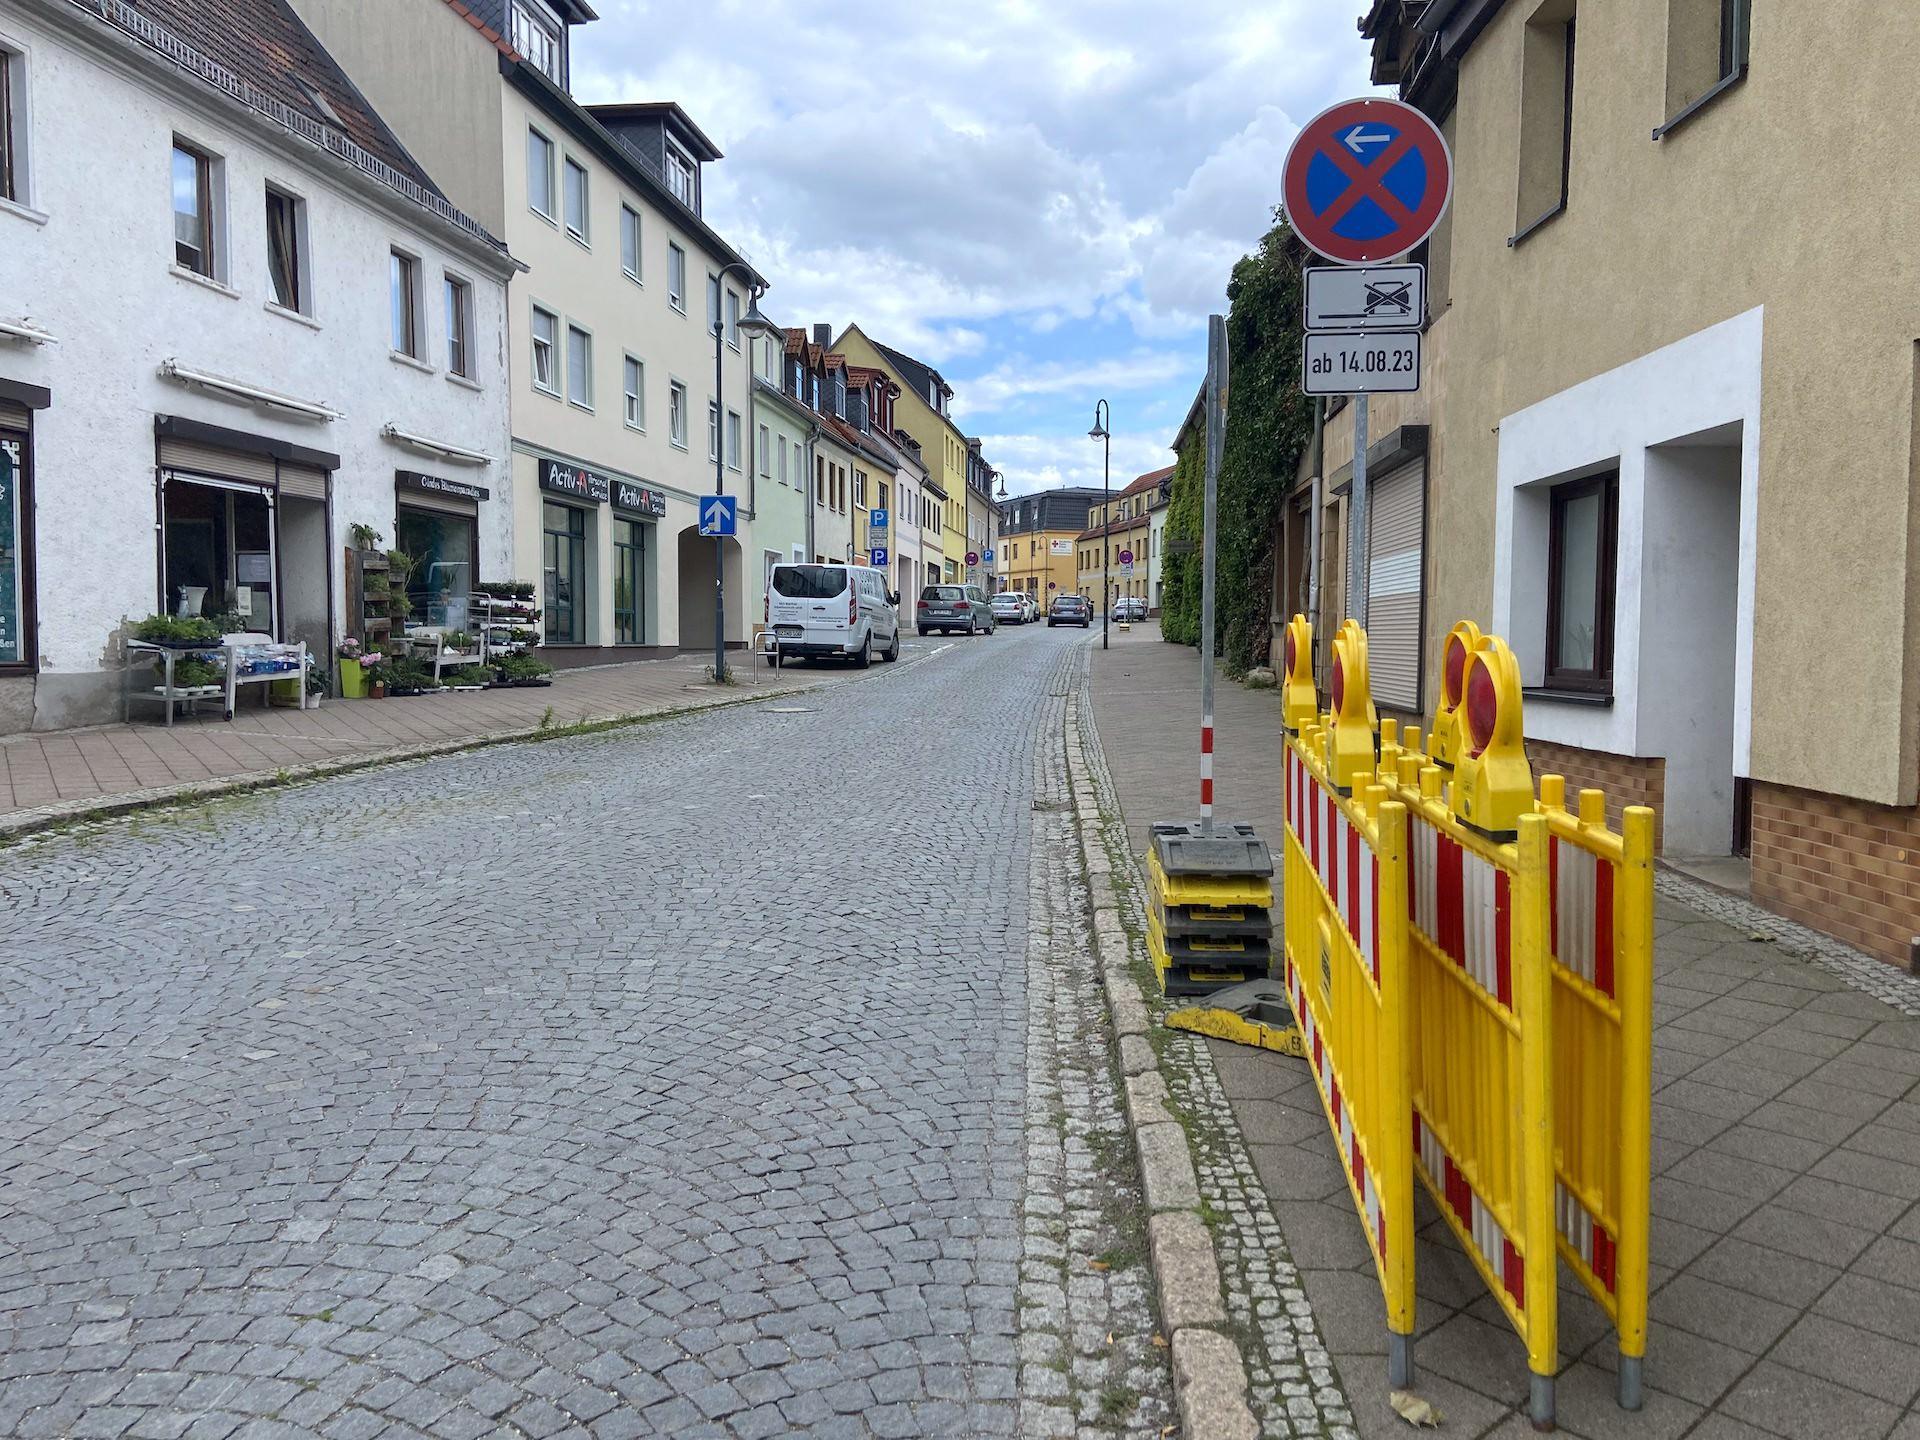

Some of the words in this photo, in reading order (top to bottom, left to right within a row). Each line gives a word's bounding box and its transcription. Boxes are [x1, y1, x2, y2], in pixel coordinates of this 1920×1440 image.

[1312, 352, 1332, 373] ab
[1339, 350, 1413, 373] 14.08.23
[874, 511, 885, 526] P
[874, 550, 885, 565] P
